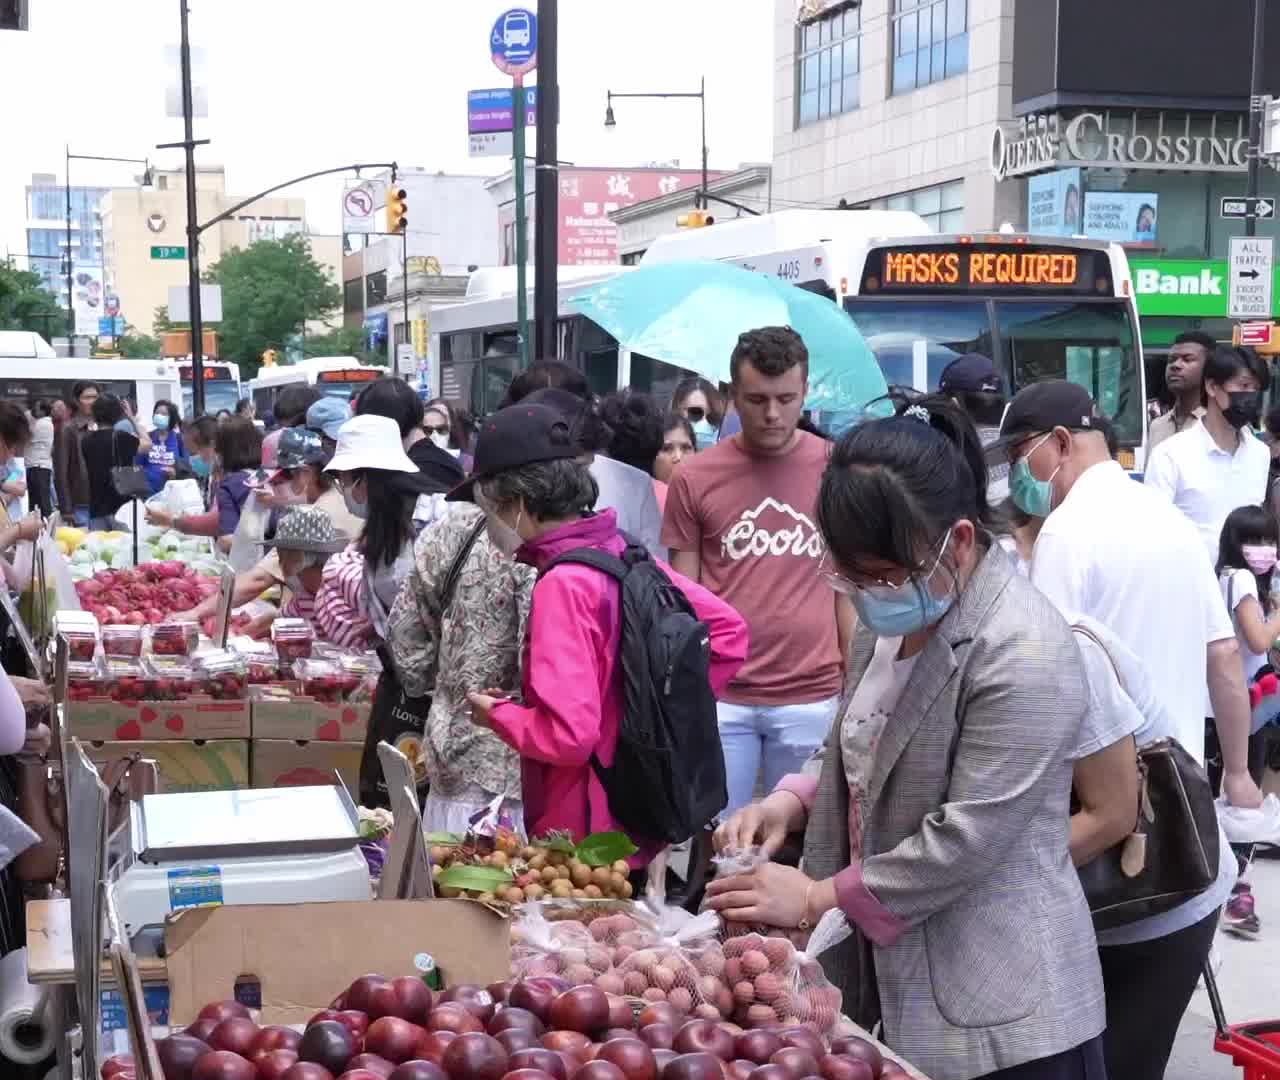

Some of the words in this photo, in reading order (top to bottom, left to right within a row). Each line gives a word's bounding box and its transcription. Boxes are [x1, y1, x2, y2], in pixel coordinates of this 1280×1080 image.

[1235, 255, 1267, 265] TRAFFIC
[1242, 243, 1262, 253] ALL
[777, 260, 800, 280] 4405
[886, 253, 960, 283] MASKS
[970, 254, 1077, 283] REQUIRED
[1136, 268, 1223, 296] Bank
[721, 520, 822, 560] Coors
